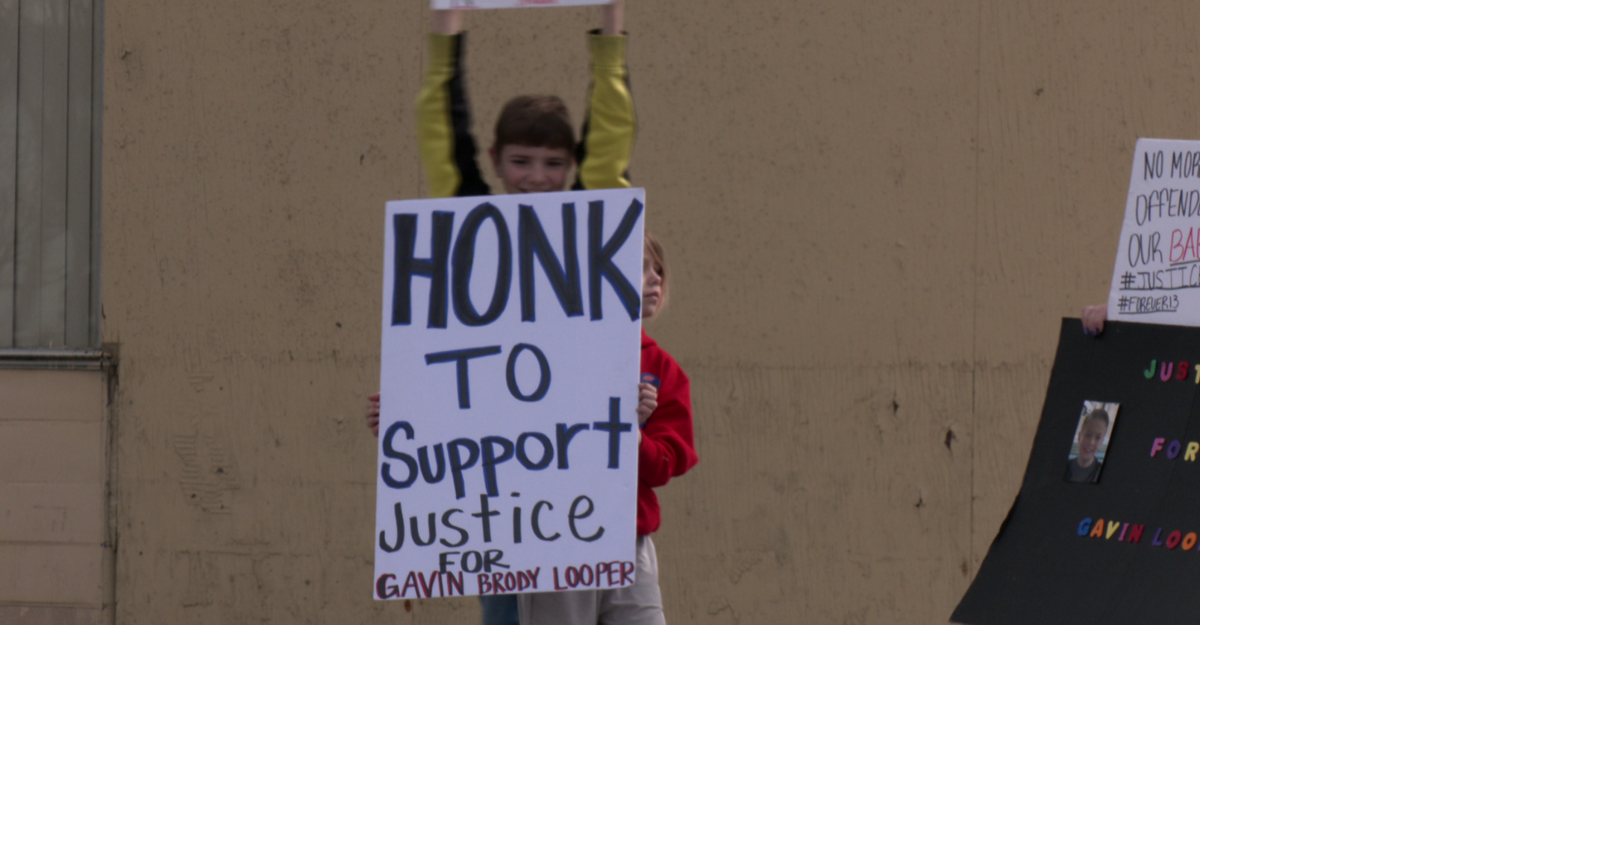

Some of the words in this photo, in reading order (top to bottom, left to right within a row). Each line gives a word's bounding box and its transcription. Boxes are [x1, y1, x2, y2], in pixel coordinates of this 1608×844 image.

[1143, 150, 1164, 180] NO
[1135, 187, 1200, 226] OFFEND
[391, 198, 644, 329] HONK
[1128, 232, 1163, 267] OUR
[1119, 264, 1200, 290] #JUSTIC
[1117, 294, 1179, 313] #FOREVER13
[425, 343, 551, 409] TO
[381, 397, 632, 499] Support
[1150, 437, 1200, 462] FOR
[379, 492, 605, 553] Justice
[1077, 517, 1145, 543] GAVIN
[1151, 527, 1200, 550] LOO
[439, 549, 510, 574] FOR
[376, 570, 464, 599] GAVIN
[477, 566, 540, 595] BRODY
[553, 561, 634, 590] LOOPER
